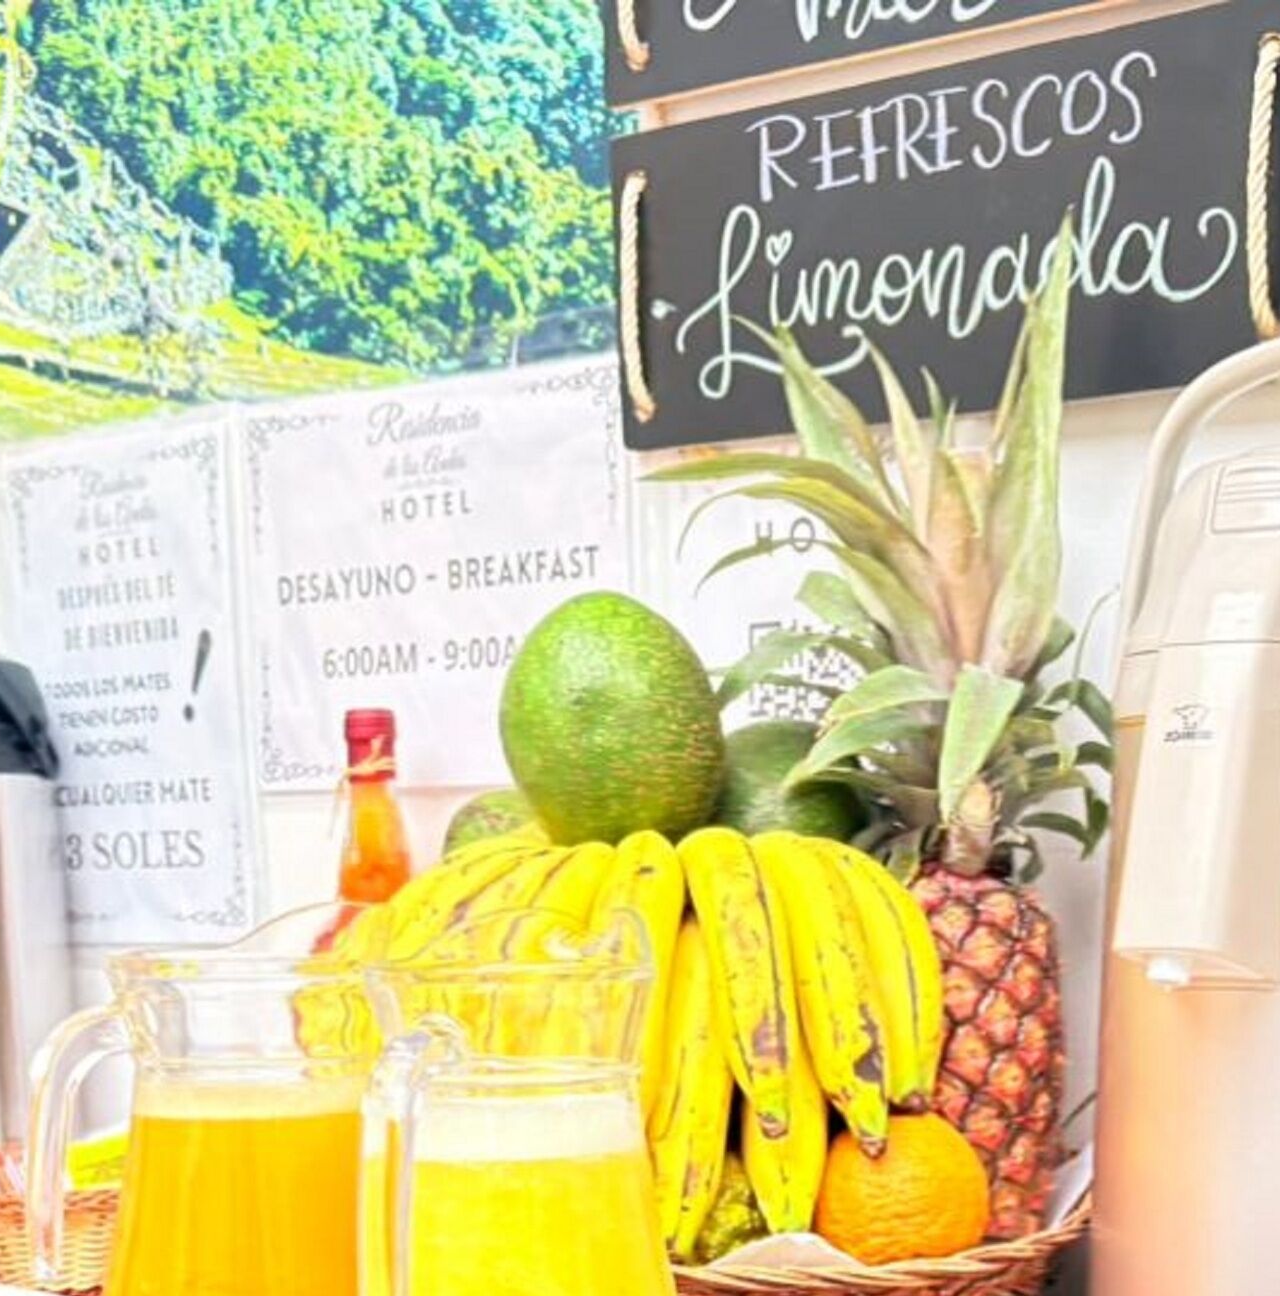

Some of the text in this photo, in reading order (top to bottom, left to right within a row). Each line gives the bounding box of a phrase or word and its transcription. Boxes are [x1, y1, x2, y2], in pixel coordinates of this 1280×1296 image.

[747, 51, 1157, 200] REFRESCOS
[677, 156, 1238, 398] Limonada
[381, 489, 473, 524] HOTEL
[79, 537, 160, 567] HOTEL
[277, 563, 417, 606] DESAYUNO
[447, 545, 600, 591] BREAKFAST
[322, 643, 418, 679] 6:00AM
[444, 634, 519, 671] 9:00A
[111, 704, 159, 726] COSTO
[54, 778, 211, 807] CUALQUIER MATE
[65, 829, 206, 871] 3 SOLES
